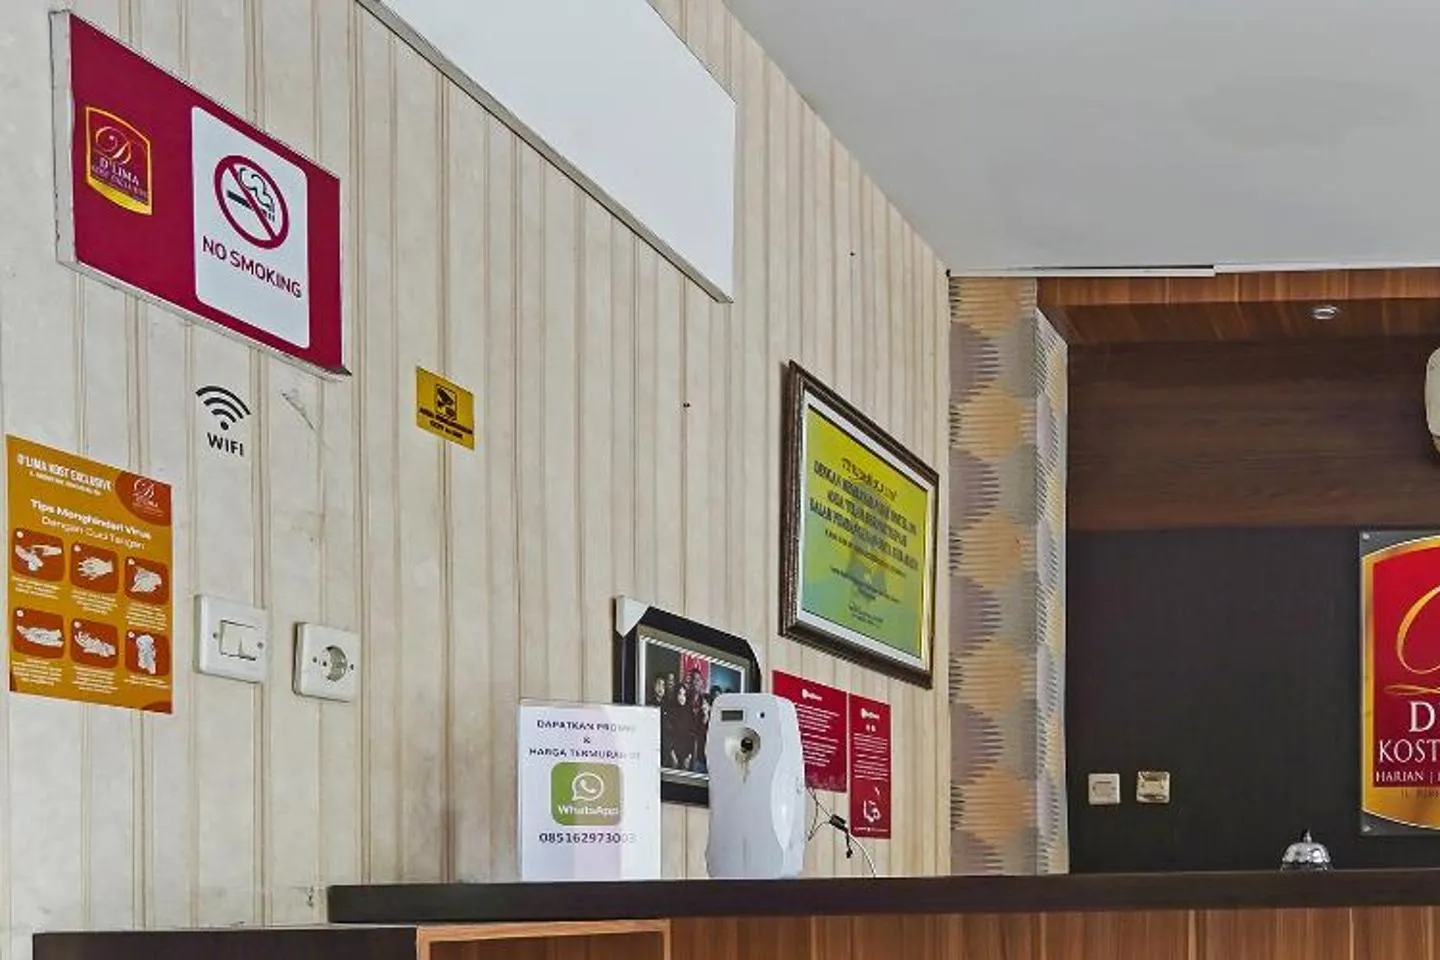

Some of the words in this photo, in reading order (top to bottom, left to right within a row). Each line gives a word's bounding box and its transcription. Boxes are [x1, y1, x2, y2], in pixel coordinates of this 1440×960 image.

[202, 235, 227, 261] NO
[229, 250, 302, 299] SMOKING
[206, 432, 244, 456] WIFI
[30, 498, 55, 514] Tips
[537, 719, 594, 731] DAPATKAN
[529, 748, 567, 757] HARGA
[1375, 771, 1424, 783] HARIAN
